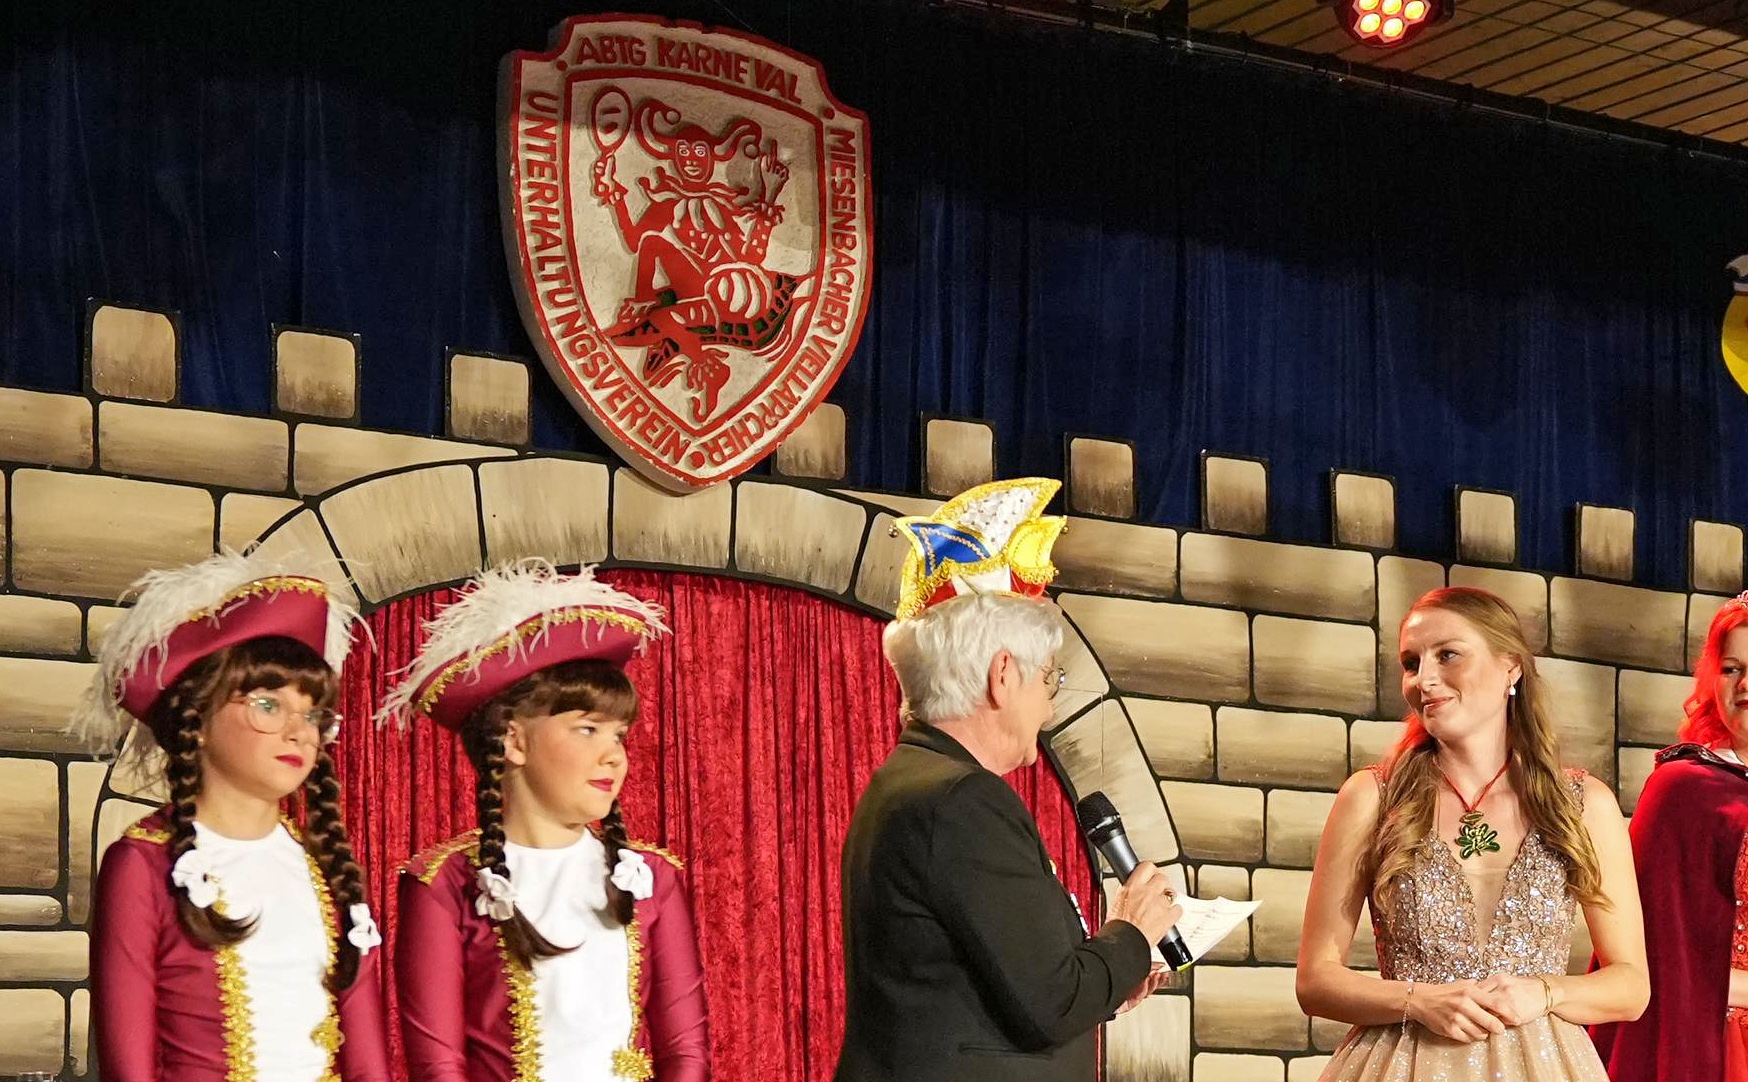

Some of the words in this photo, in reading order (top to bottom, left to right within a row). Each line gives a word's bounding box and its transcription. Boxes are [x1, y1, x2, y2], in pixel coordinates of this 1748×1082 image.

[577, 36, 646, 66] ABTG
[656, 36, 802, 105] KARNEVAL
[524, 91, 691, 464] UNTERHALTUNGSVEREIN
[819, 129, 857, 336] MIESENBACHER
